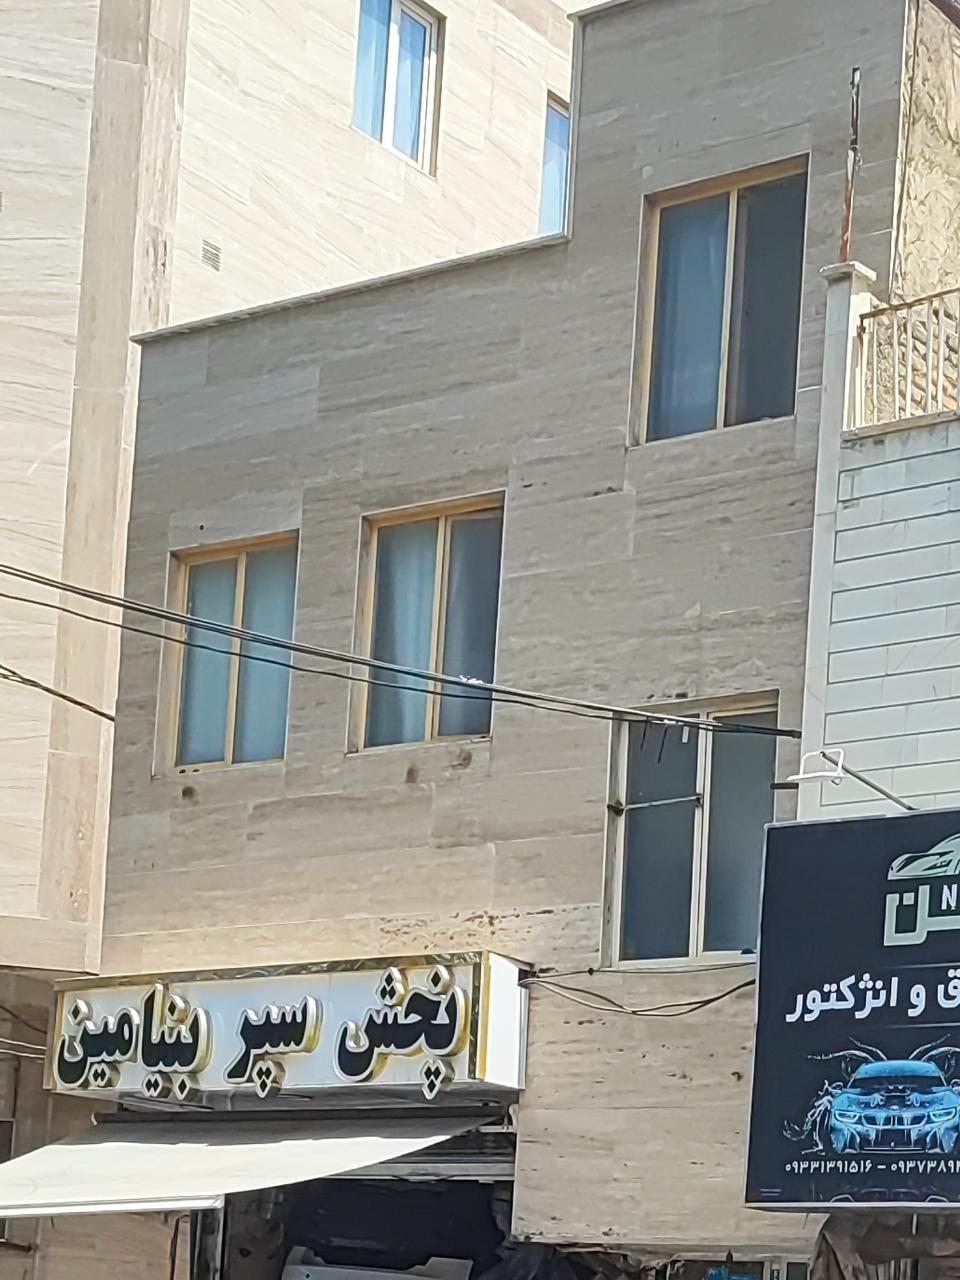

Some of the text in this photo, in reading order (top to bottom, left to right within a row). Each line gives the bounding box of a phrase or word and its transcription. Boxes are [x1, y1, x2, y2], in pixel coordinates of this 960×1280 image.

[785, 973, 899, 1023] انژکتور
[907, 984, 926, 1017] و
[54, 964, 470, 1099] پخش سپر بنیامین
